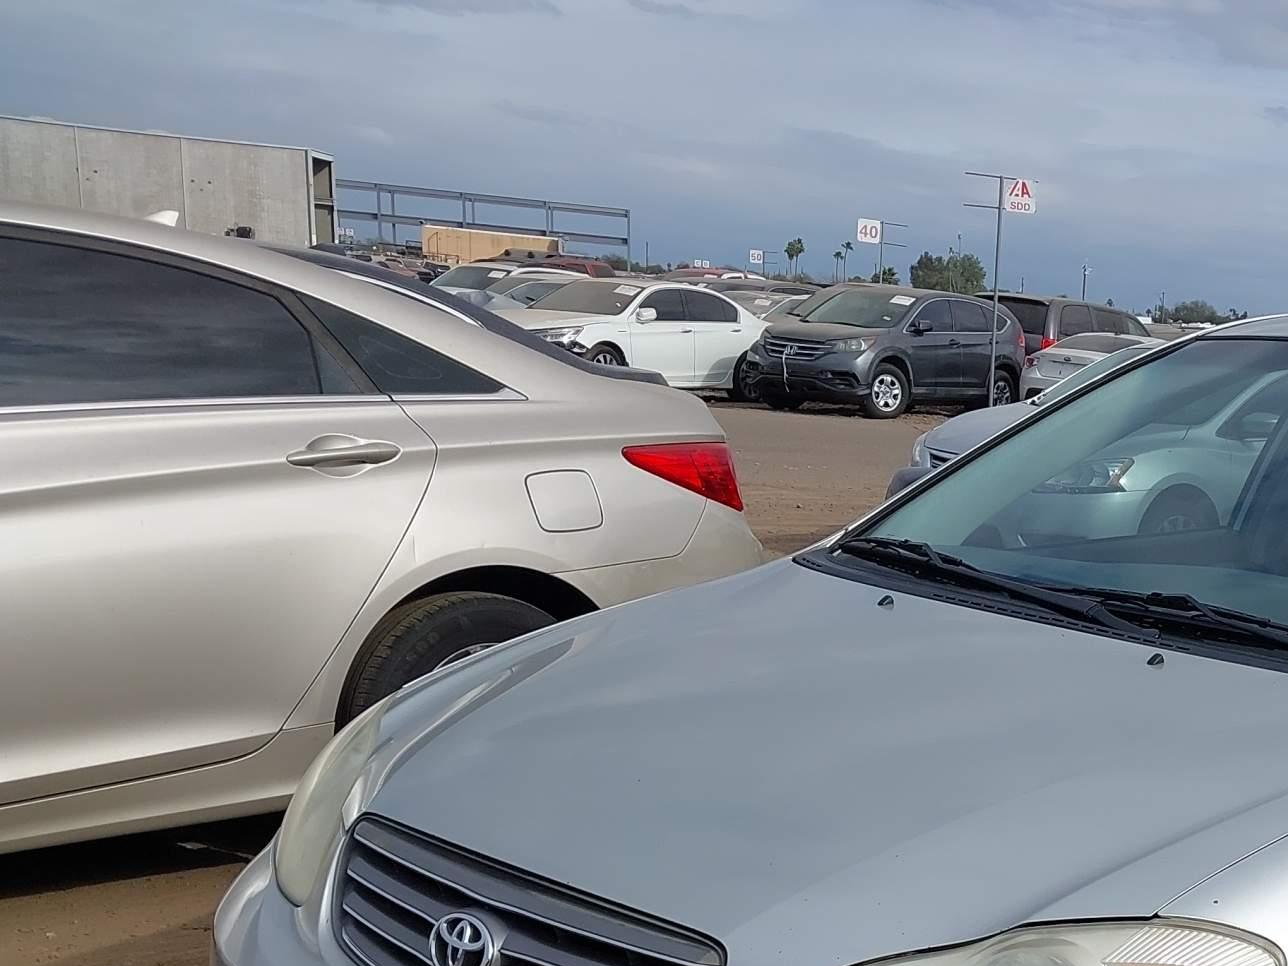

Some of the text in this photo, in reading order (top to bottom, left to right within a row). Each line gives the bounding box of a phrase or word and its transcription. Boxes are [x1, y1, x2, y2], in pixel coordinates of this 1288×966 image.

[1010, 201, 1031, 212] SDD
[859, 224, 879, 239] 40
[751, 252, 761, 261] 50
